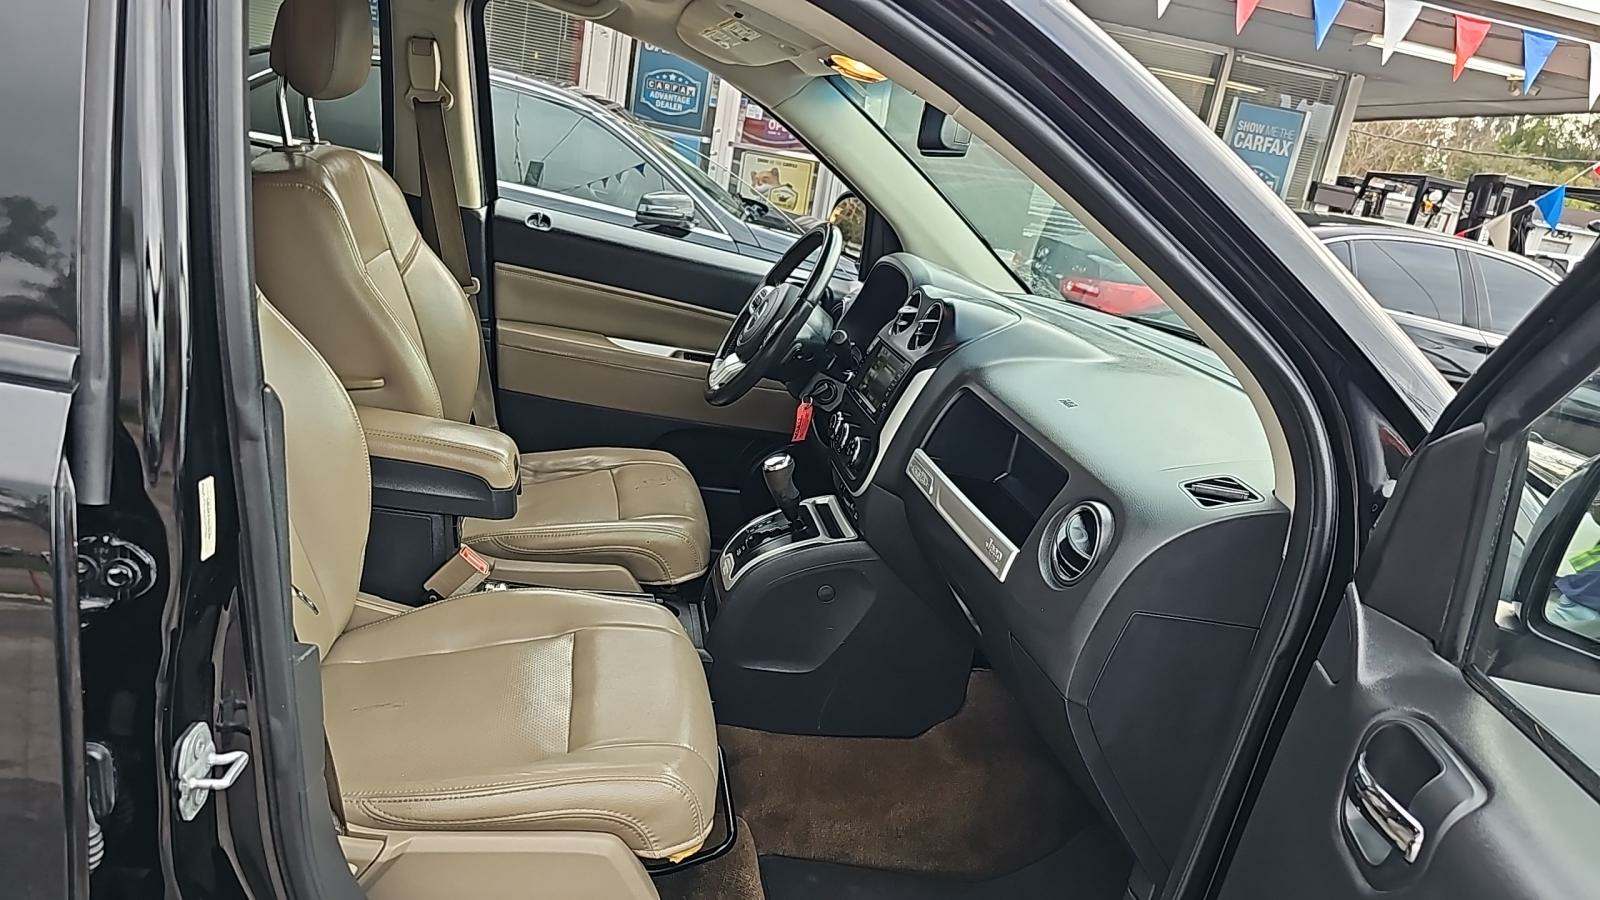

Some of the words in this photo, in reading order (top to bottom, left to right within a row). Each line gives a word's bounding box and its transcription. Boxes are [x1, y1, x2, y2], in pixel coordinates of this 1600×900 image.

[648, 80, 696, 97] CARFAX
[649, 91, 691, 105] ADVANTAGE
[655, 100, 683, 111] DEALER
[1237, 119, 1265, 134] SHOW
[1263, 125, 1279, 137] ME
[1280, 127, 1296, 140] THE
[1233, 131, 1294, 157] CARFAX
